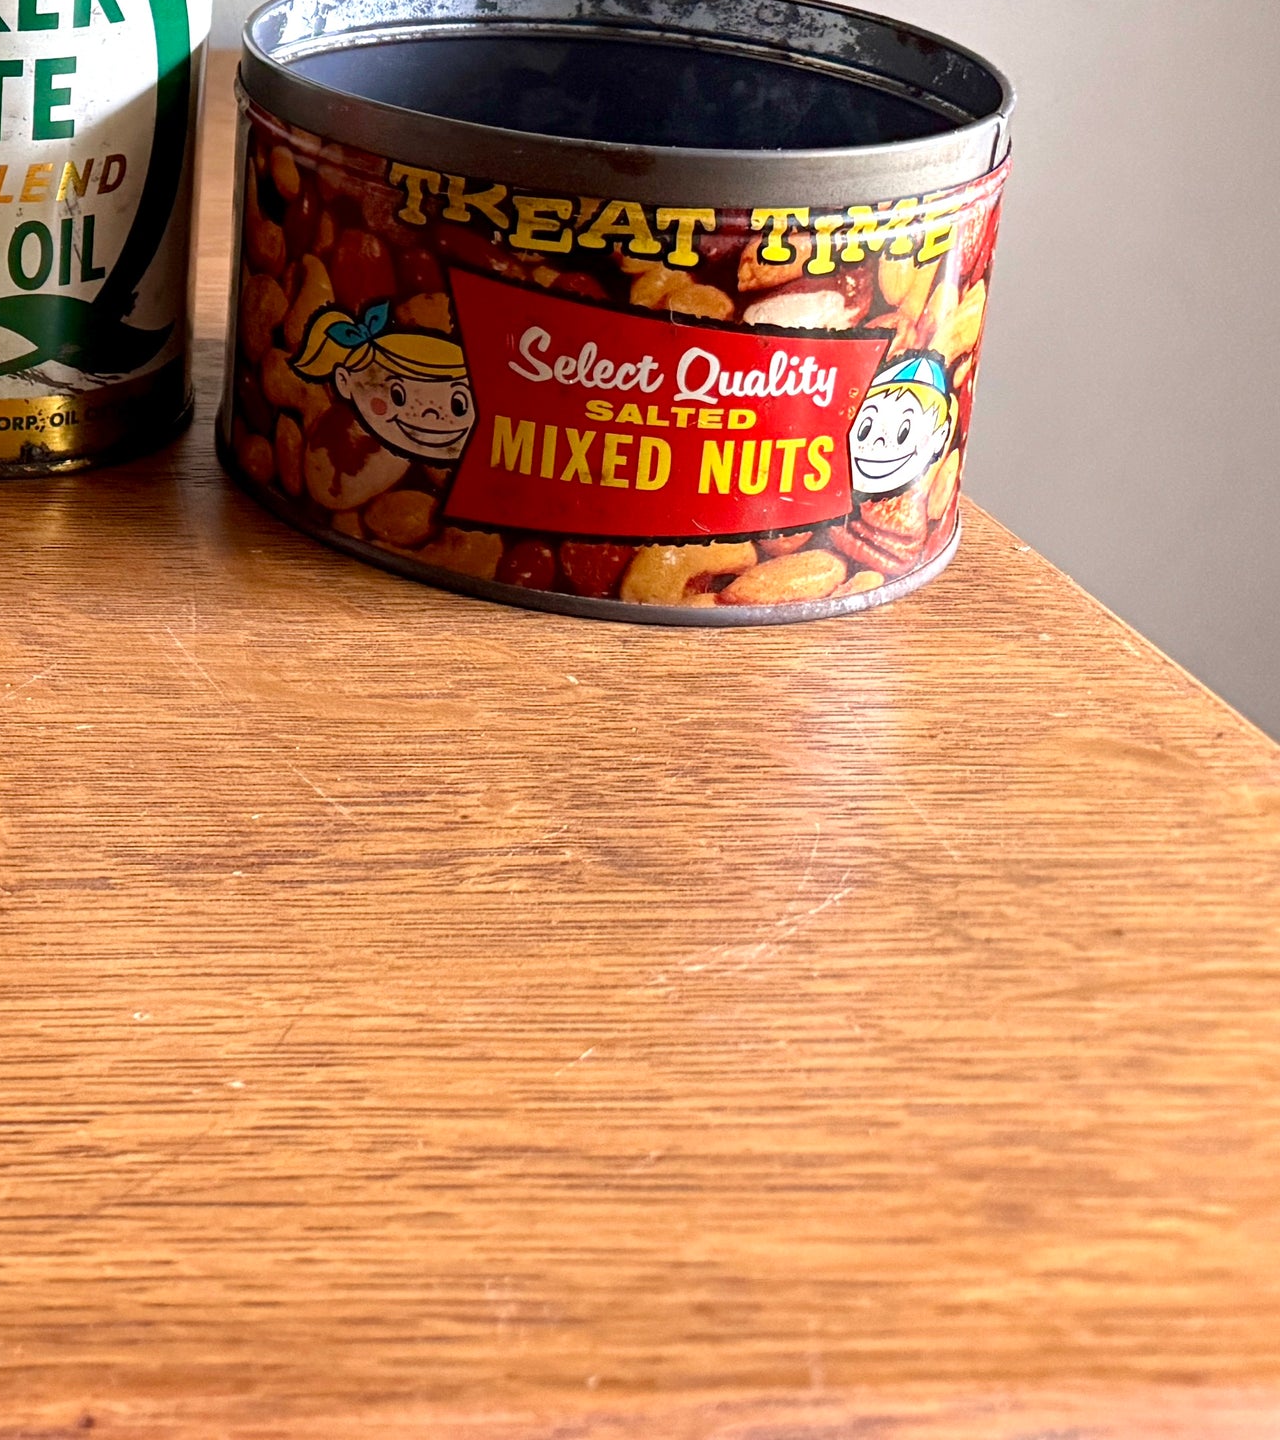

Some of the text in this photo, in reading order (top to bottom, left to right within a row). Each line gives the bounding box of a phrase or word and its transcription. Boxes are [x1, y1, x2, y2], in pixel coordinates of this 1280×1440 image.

[7, 214, 106, 291] OIL
[750, 193, 962, 275] TIME
[508, 326, 838, 408] Select Quality
[49, 410, 80, 428] OIL
[585, 399, 757, 430] SALTED
[491, 415, 835, 495] MIXED NUTS
